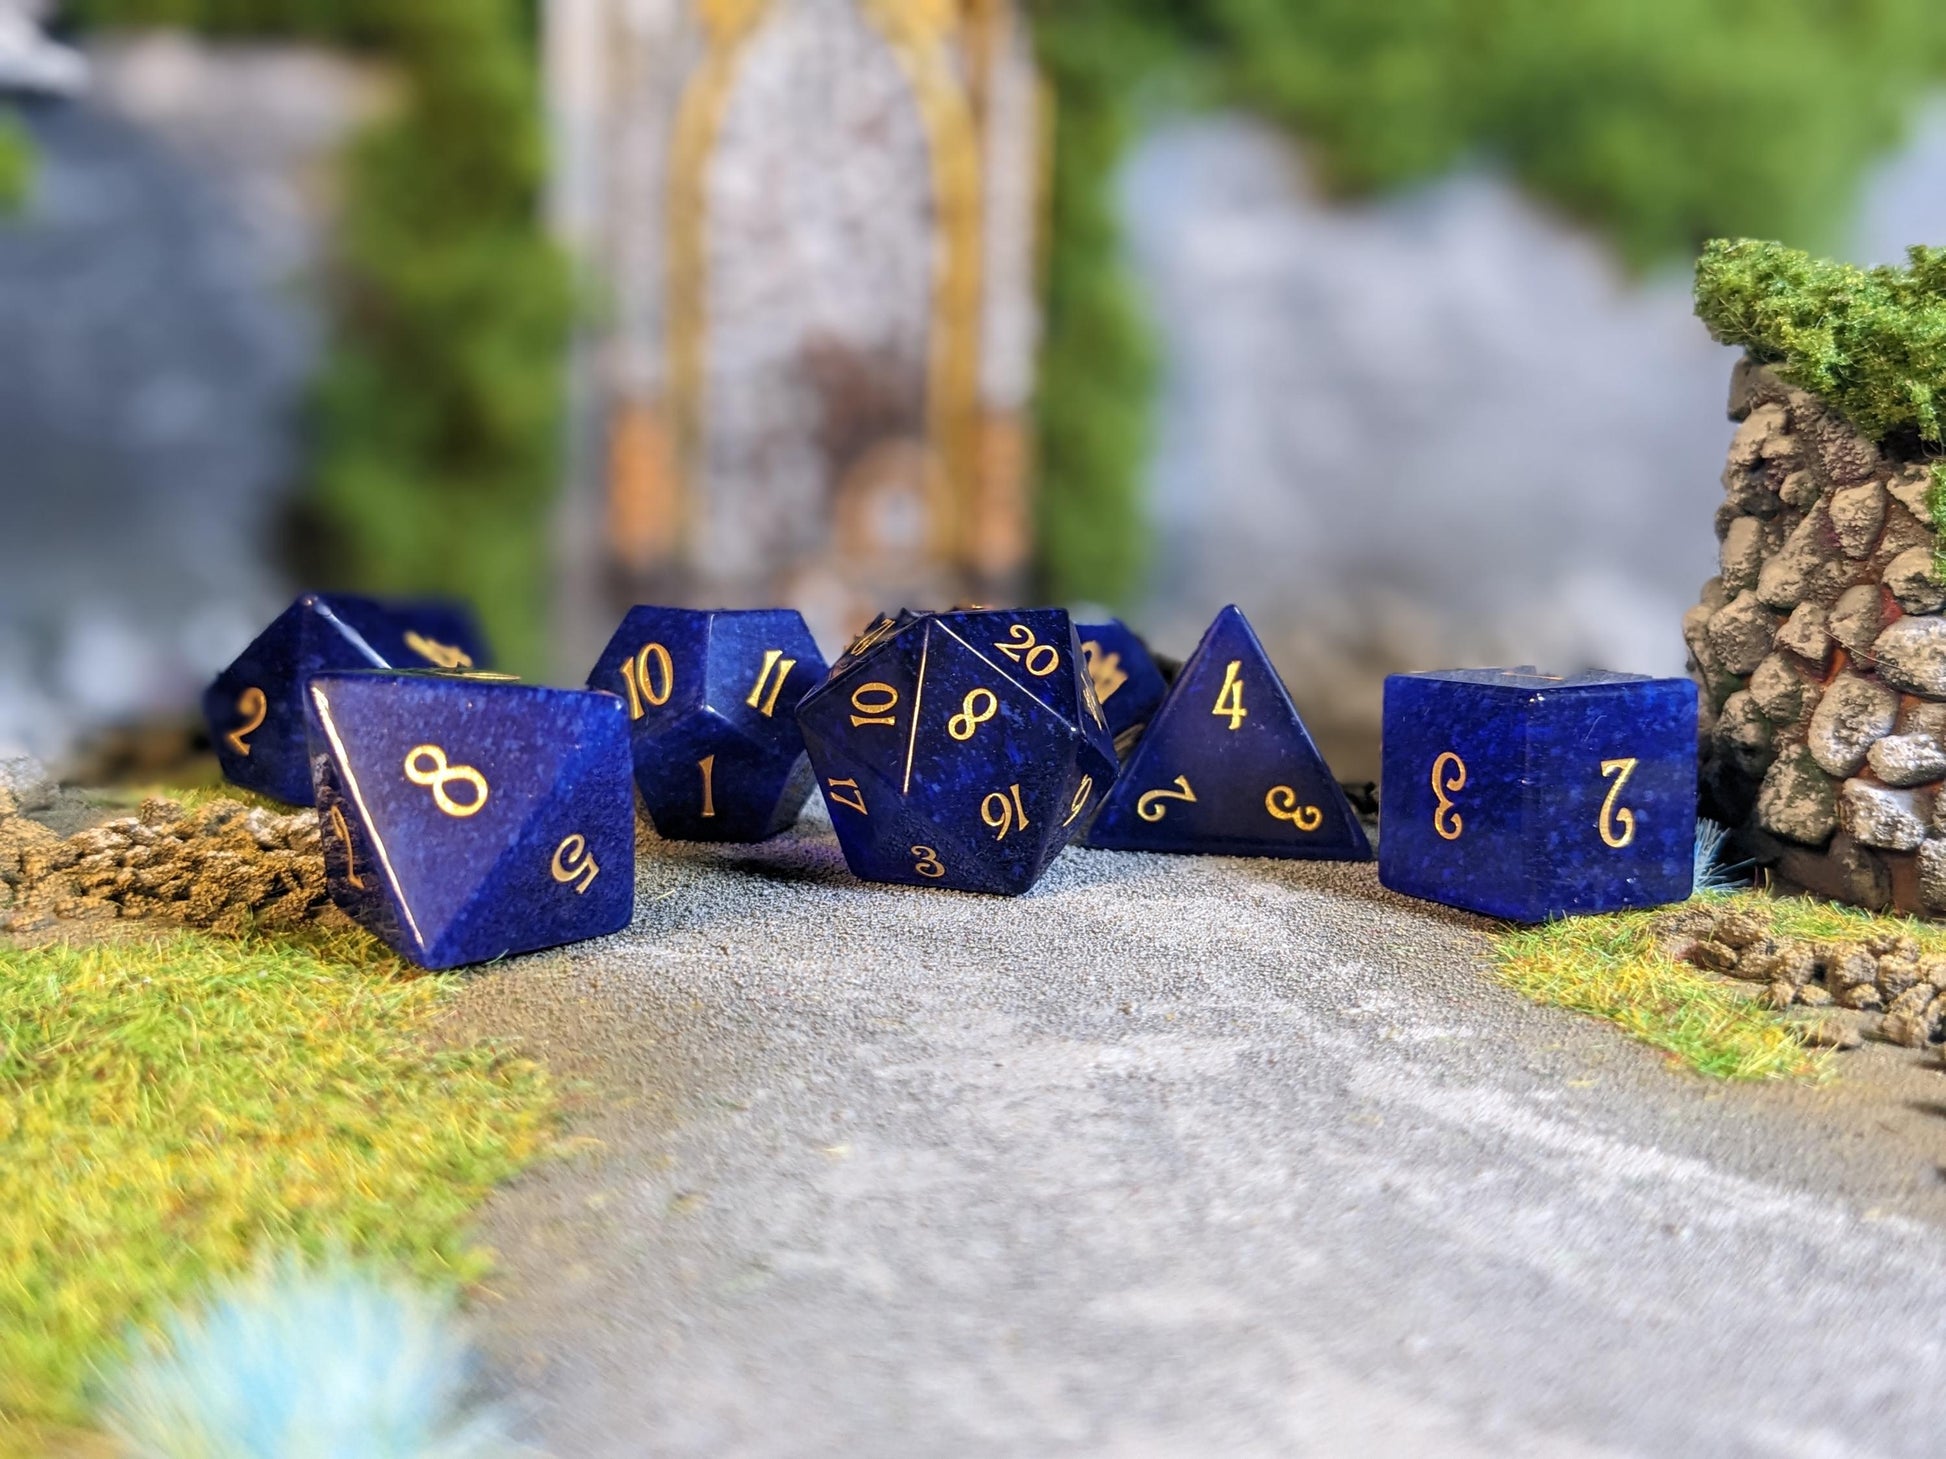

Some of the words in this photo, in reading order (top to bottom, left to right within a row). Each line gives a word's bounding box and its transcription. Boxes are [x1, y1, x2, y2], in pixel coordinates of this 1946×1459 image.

[619, 643, 674, 720] 10
[993, 624, 1060, 677] 20
[745, 649, 797, 718] 11
[850, 682, 899, 727] 10
[948, 688, 998, 740] 8
[1211, 660, 1248, 730] 4
[226, 686, 267, 756] 2
[404, 743, 489, 818] 8
[698, 754, 715, 817] 1
[827, 777, 869, 816] 17
[1137, 774, 1198, 822] 2
[1265, 785, 1323, 832] 3
[1431, 751, 1467, 840] 3
[1599, 757, 1638, 849] 2
[980, 783, 1030, 841] 16
[551, 833, 600, 895] 5
[910, 845, 946, 878] 3
